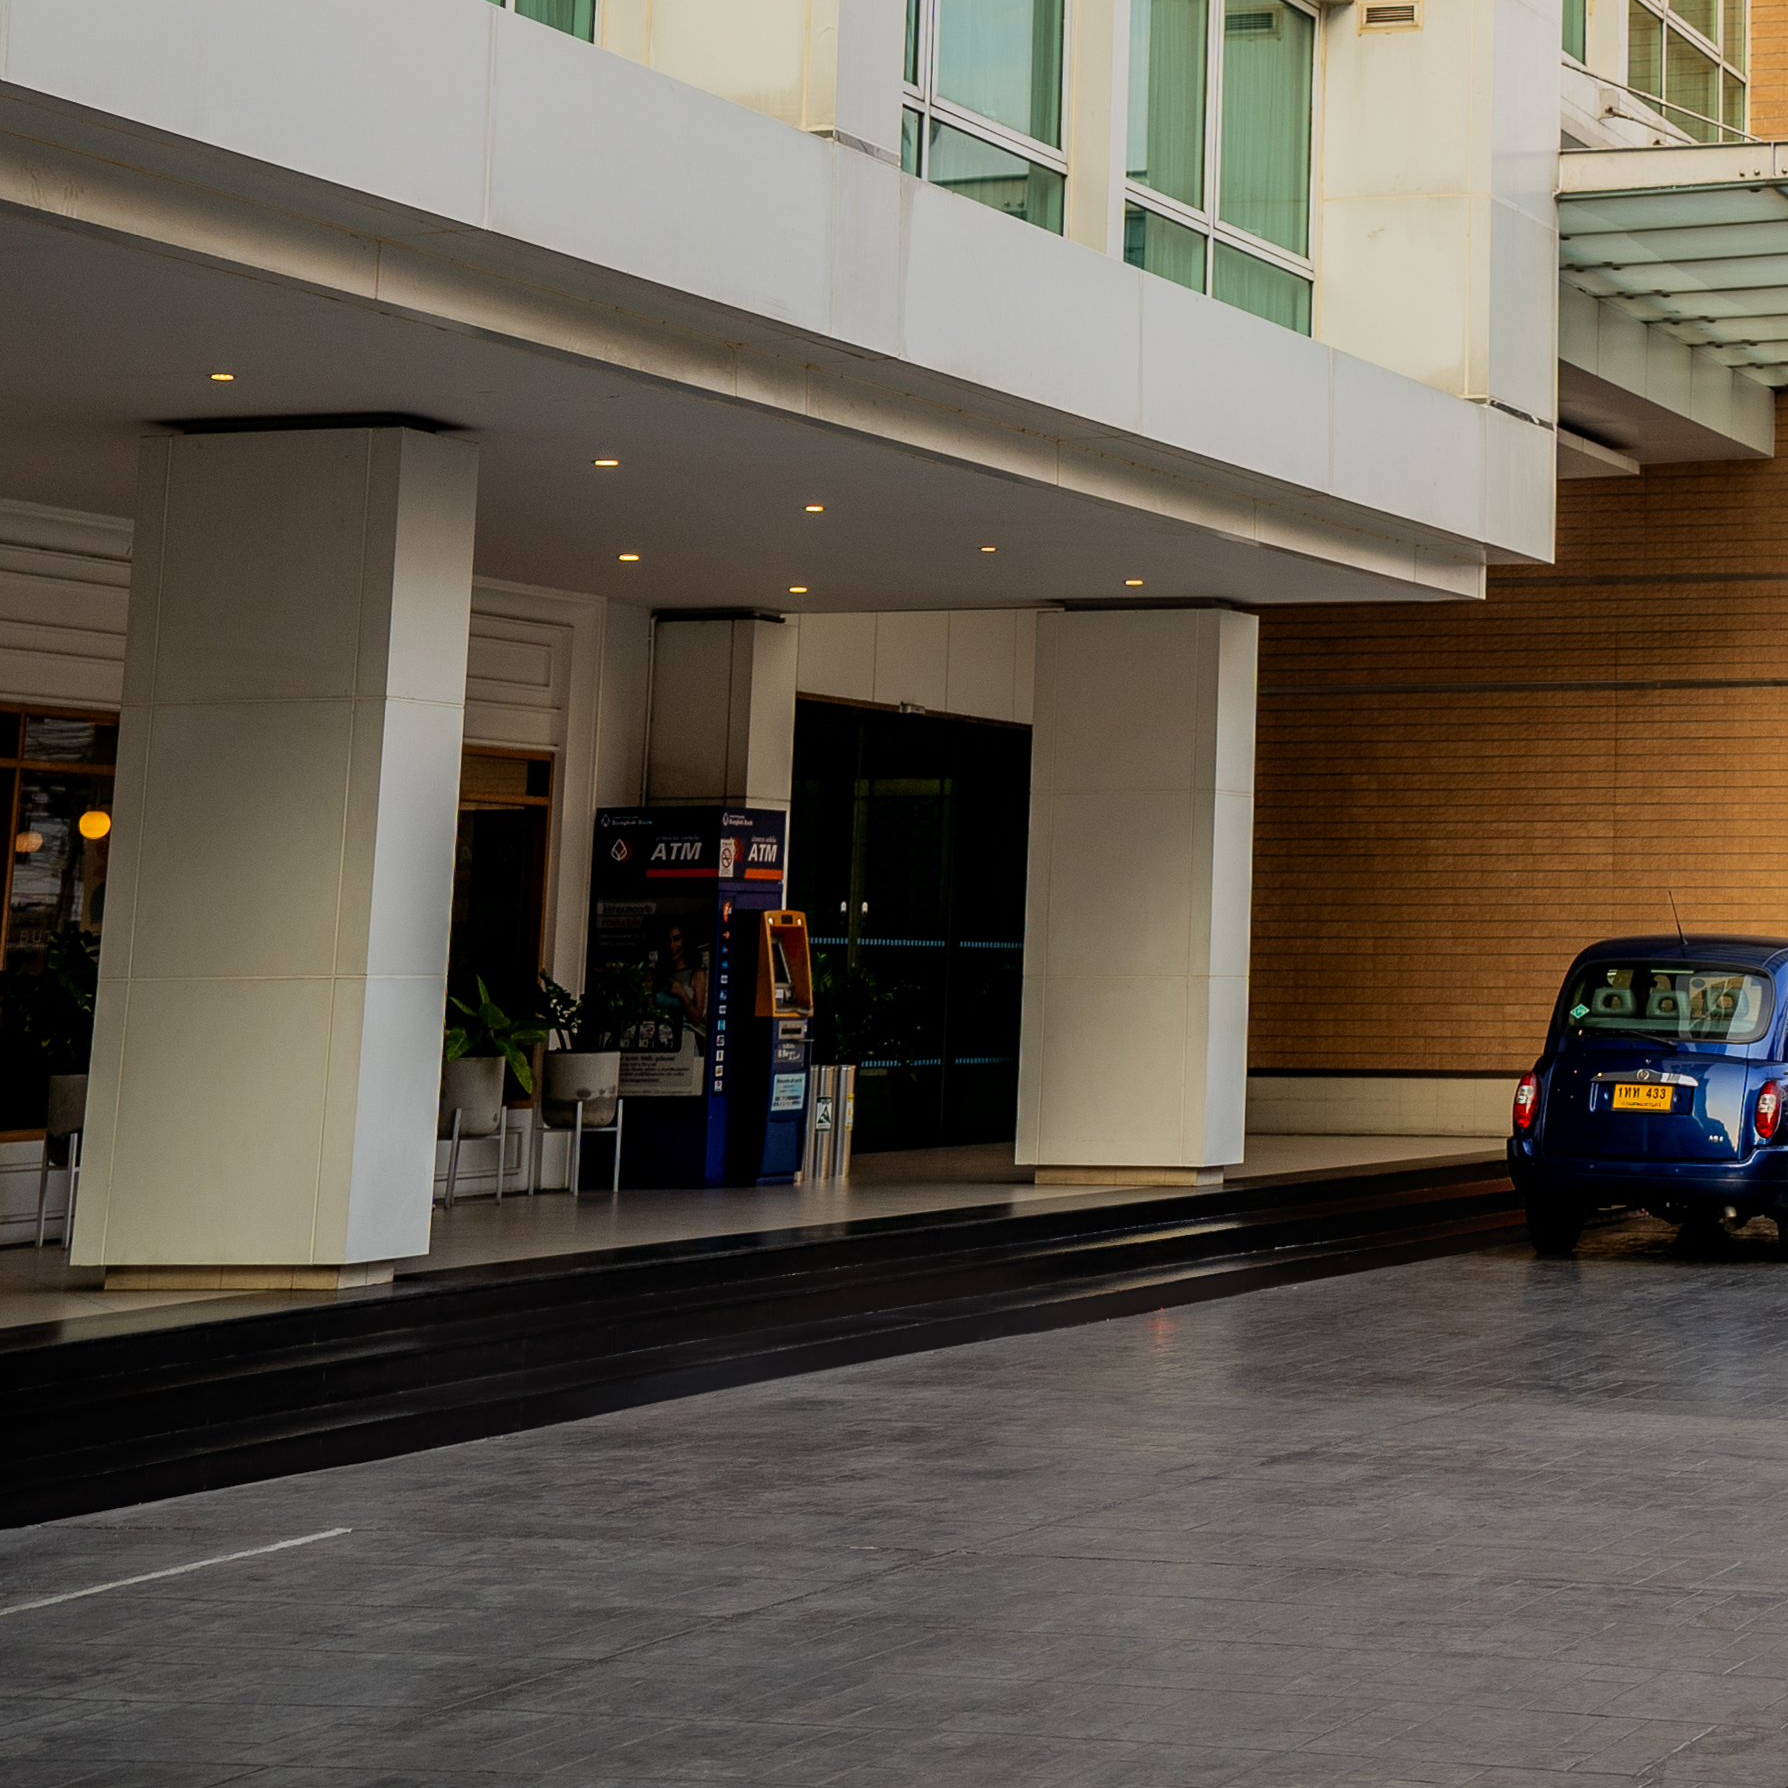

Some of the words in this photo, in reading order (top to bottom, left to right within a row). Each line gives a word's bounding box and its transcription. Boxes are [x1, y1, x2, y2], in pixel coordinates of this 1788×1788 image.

[650, 842, 703, 861] ATM
[748, 843, 778, 863] ATM
[1645, 1087, 1667, 1100] 433
